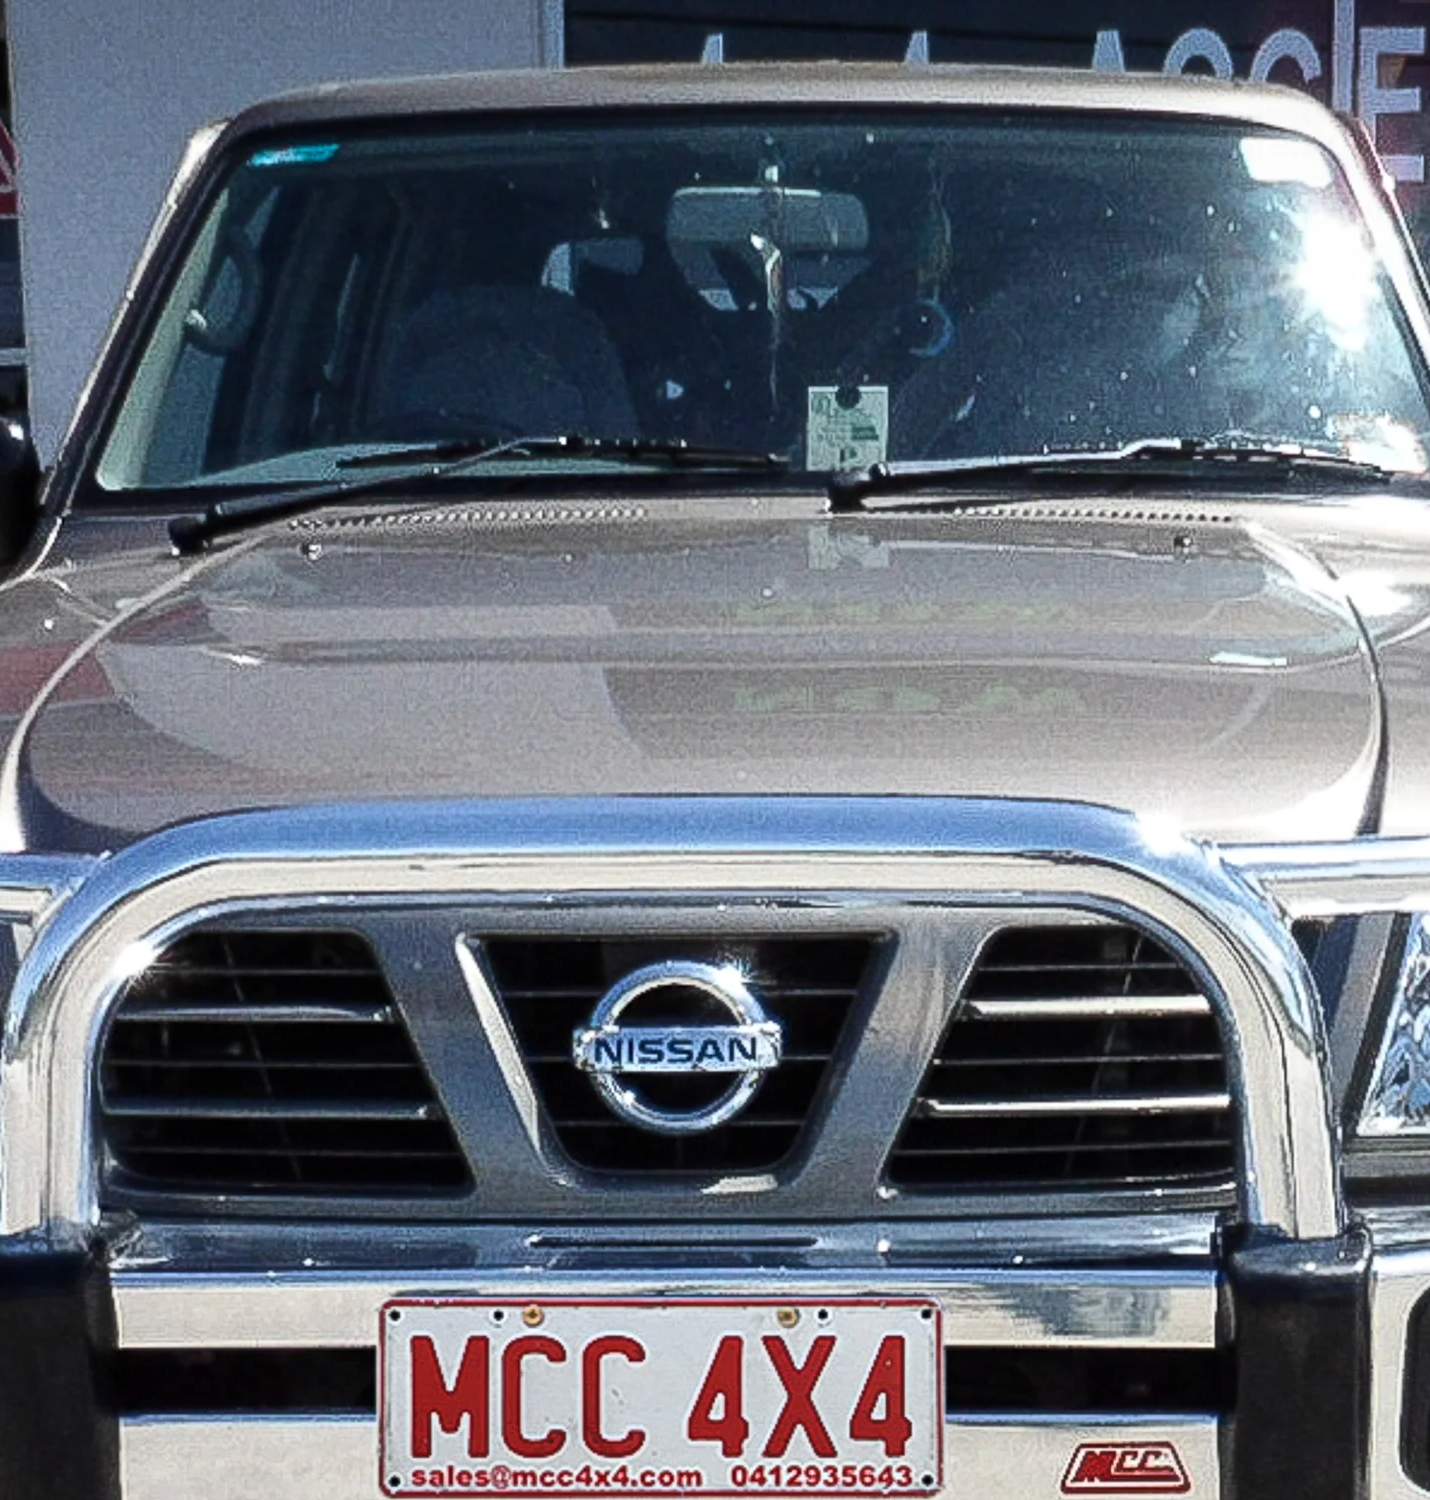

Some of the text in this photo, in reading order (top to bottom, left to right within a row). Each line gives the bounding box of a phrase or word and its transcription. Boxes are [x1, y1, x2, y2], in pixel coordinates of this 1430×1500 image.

[594, 1037, 757, 1064] NISSAN
[410, 1335, 913, 1459] MCC 4X4
[411, 1465, 913, 1489] sales@mcc4x4.com 0412935643
